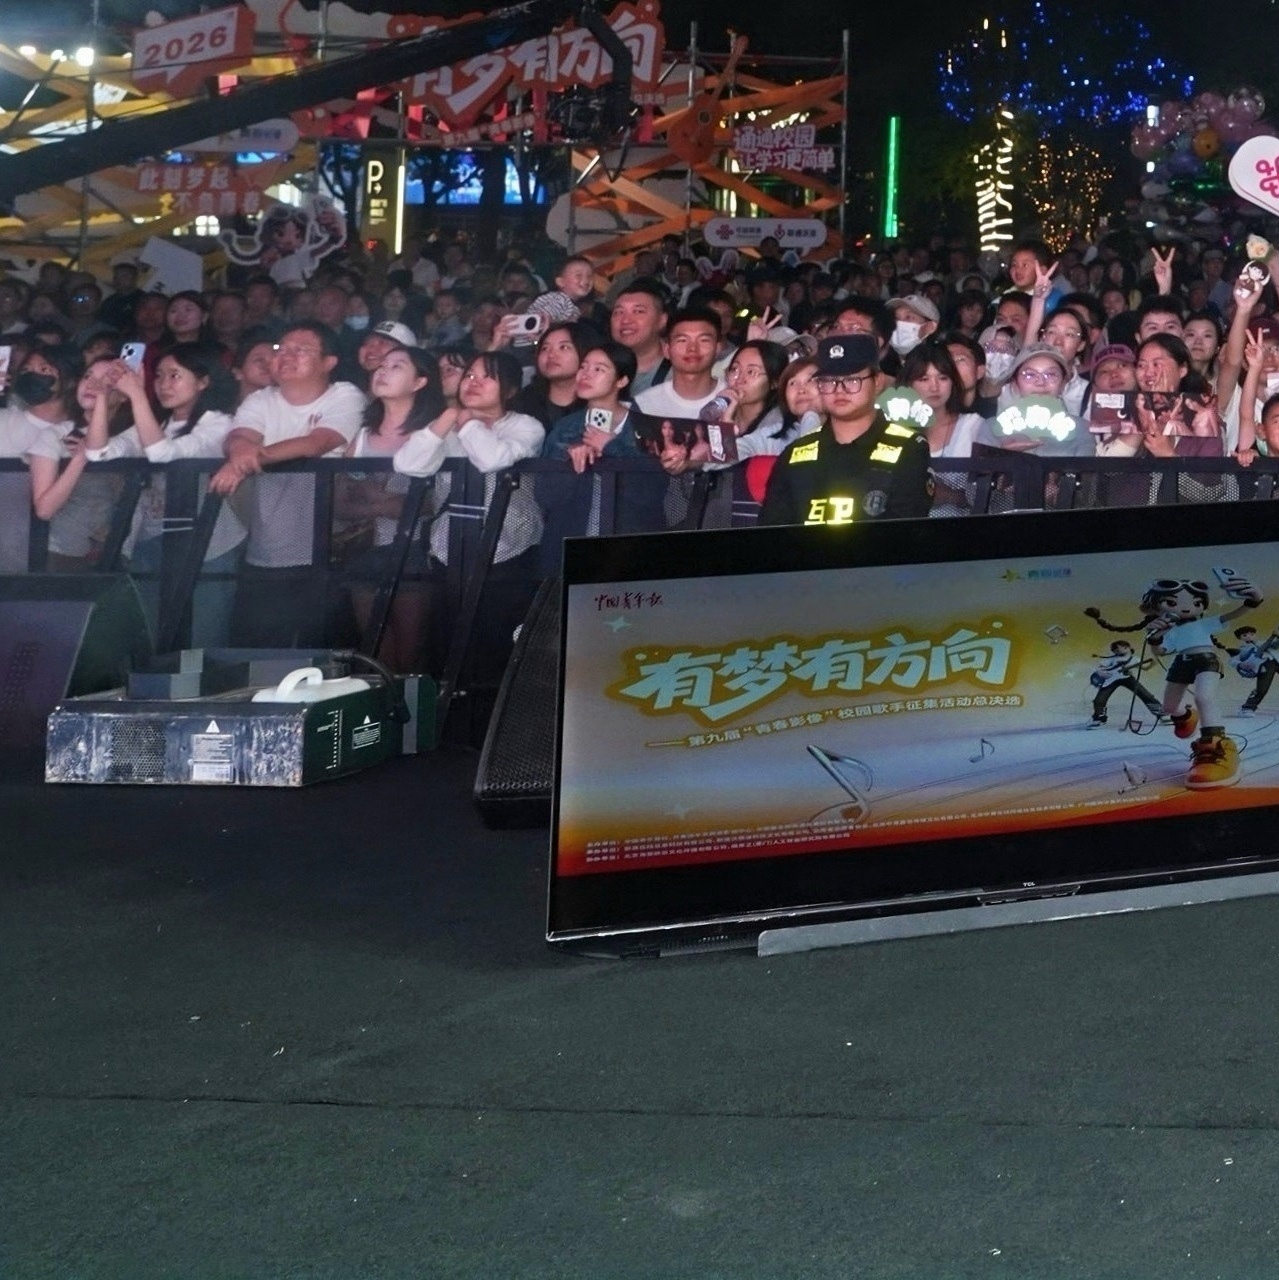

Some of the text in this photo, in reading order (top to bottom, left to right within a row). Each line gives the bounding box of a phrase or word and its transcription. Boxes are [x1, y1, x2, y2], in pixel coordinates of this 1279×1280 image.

[144, 25, 228, 68] 2026
[367, 160, 384, 194] P
[620, 627, 1012, 722] 有梦有方向
